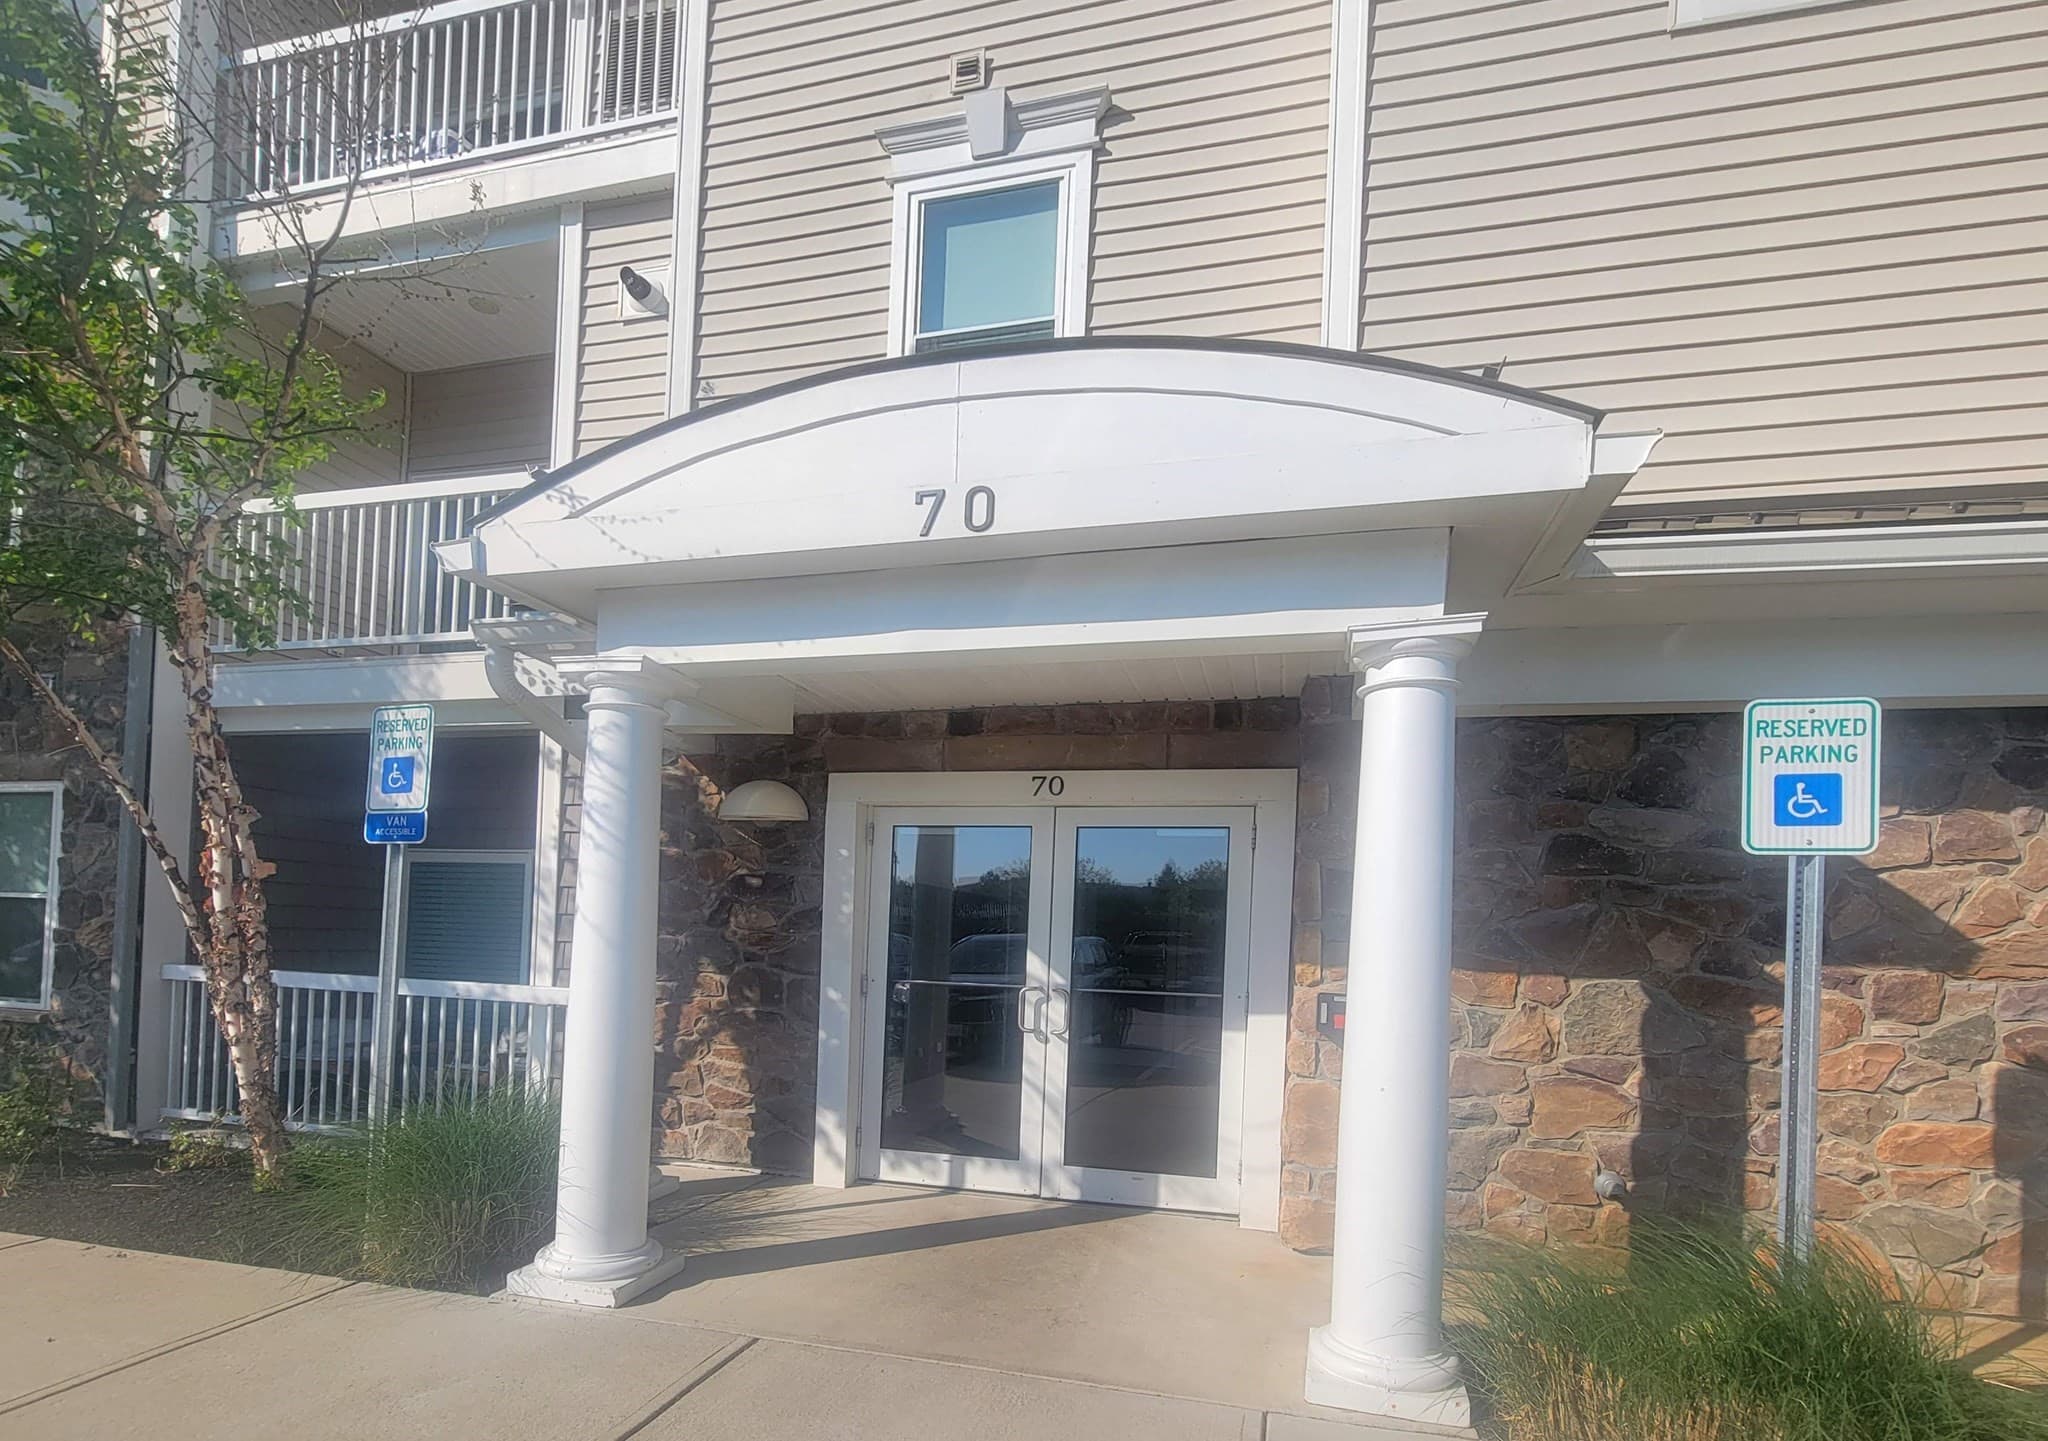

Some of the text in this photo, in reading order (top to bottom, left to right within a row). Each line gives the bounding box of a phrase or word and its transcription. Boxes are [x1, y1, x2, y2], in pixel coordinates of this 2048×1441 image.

[915, 486, 995, 536] 70
[377, 718, 428, 733] RESERVED
[1756, 718, 1867, 738] RESERVED
[377, 736, 423, 751] PARKING
[1760, 744, 1858, 764] PARKING
[1032, 776, 1064, 796] 70
[386, 816, 407, 826] VAN
[375, 828, 416, 836] ACCESSIBLE
